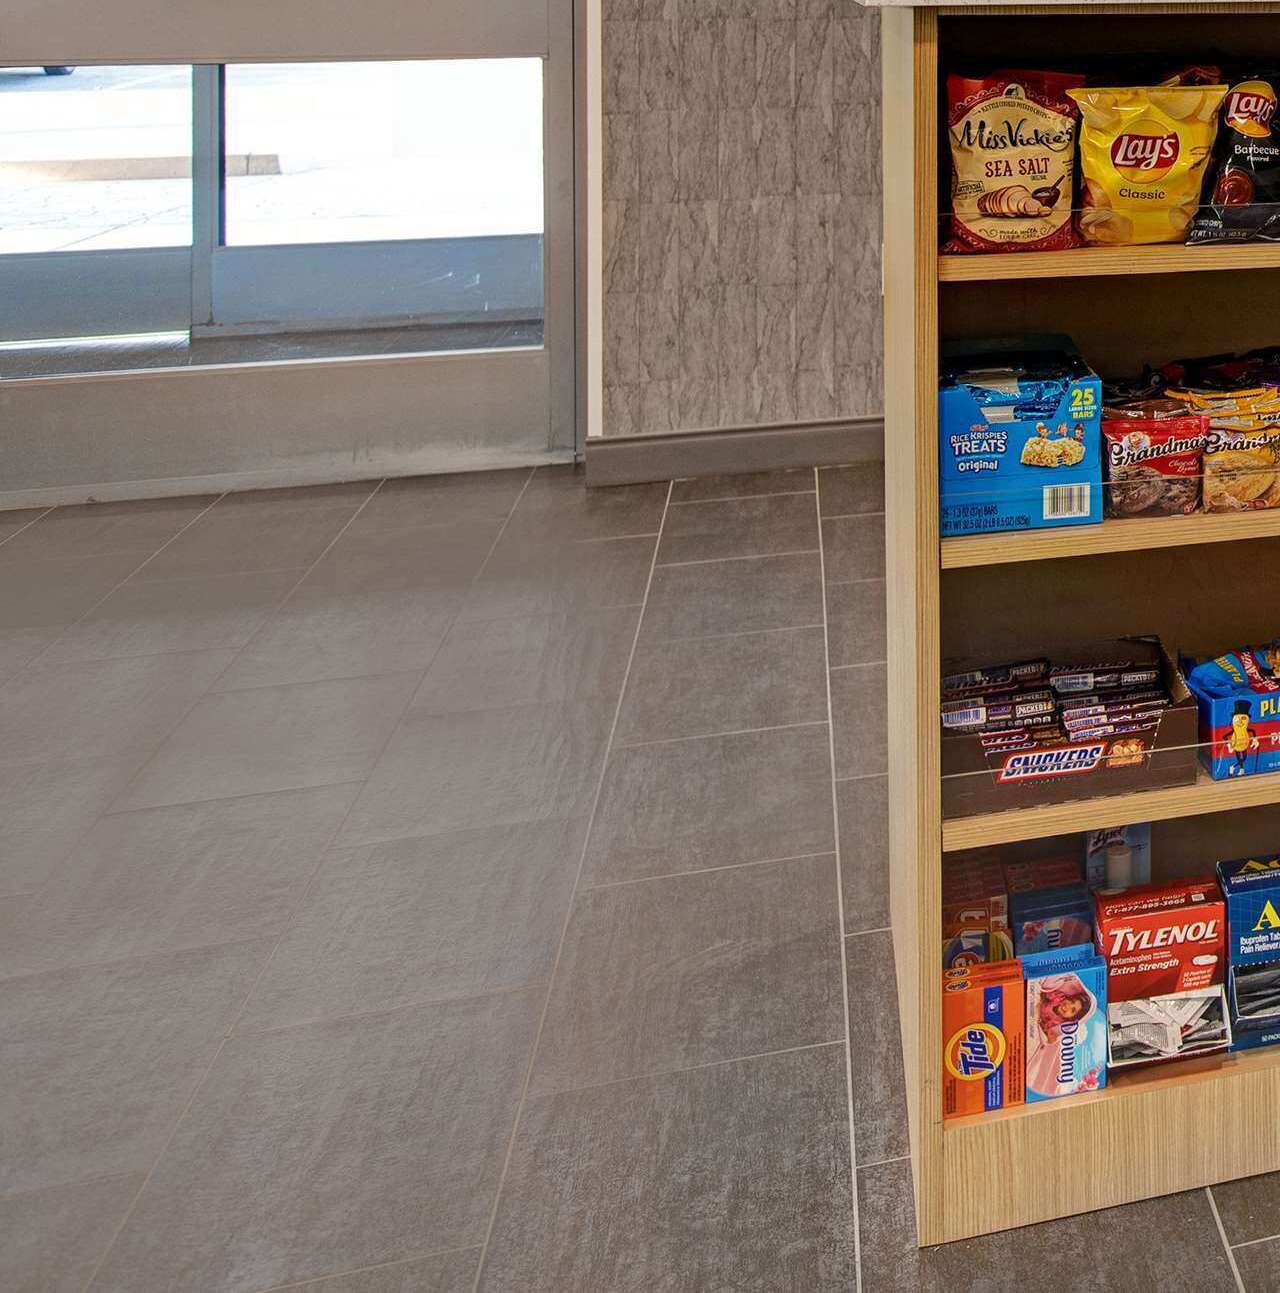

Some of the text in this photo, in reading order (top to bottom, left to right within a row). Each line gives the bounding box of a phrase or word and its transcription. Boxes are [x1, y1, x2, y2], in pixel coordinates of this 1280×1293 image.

[1114, 134, 1177, 171] Lay's
[1234, 144, 1280, 156] Barbecue
[984, 157, 1050, 178] SEA SALT
[1118, 187, 1166, 200] Classic
[1071, 387, 1095, 407] 25
[1072, 410, 1094, 419] BARS
[950, 430, 1008, 444] RICE KRISPIES
[952, 439, 1007, 456] TREATS
[1108, 919, 1218, 957] TYLENOL
[1239, 934, 1269, 945] Ibuprofen
[1239, 945, 1254, 955] Pain
[1109, 953, 1152, 966] Acetaminophen
[1109, 957, 1179, 977] Extra Strength
[959, 1028, 995, 1077] Tide
[1056, 1021, 1079, 1084] Downy
